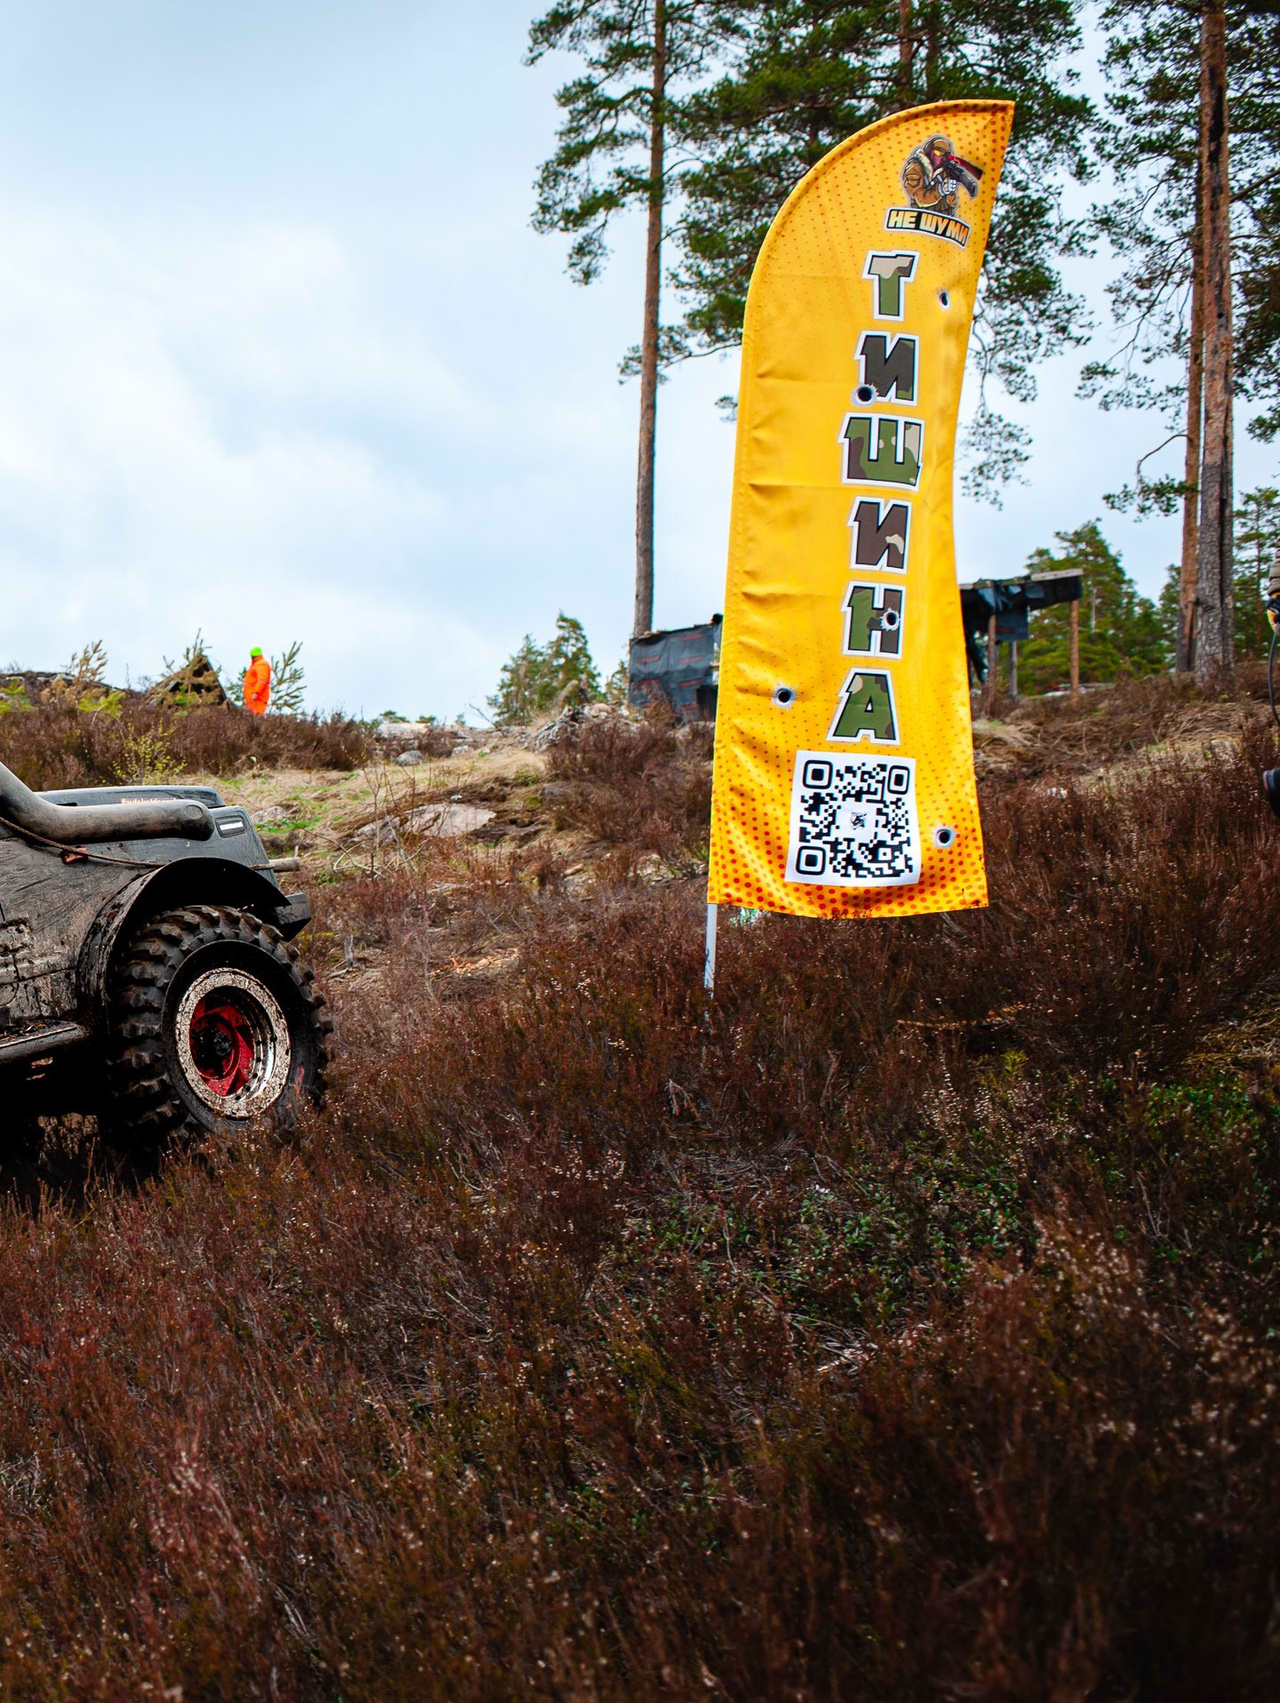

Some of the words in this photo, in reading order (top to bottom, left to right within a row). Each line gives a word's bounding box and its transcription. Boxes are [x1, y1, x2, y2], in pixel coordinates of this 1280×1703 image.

[887, 210, 918, 229] НЕ
[919, 212, 969, 245] ШУМИ
[827, 250, 924, 744] ТИШИНА
